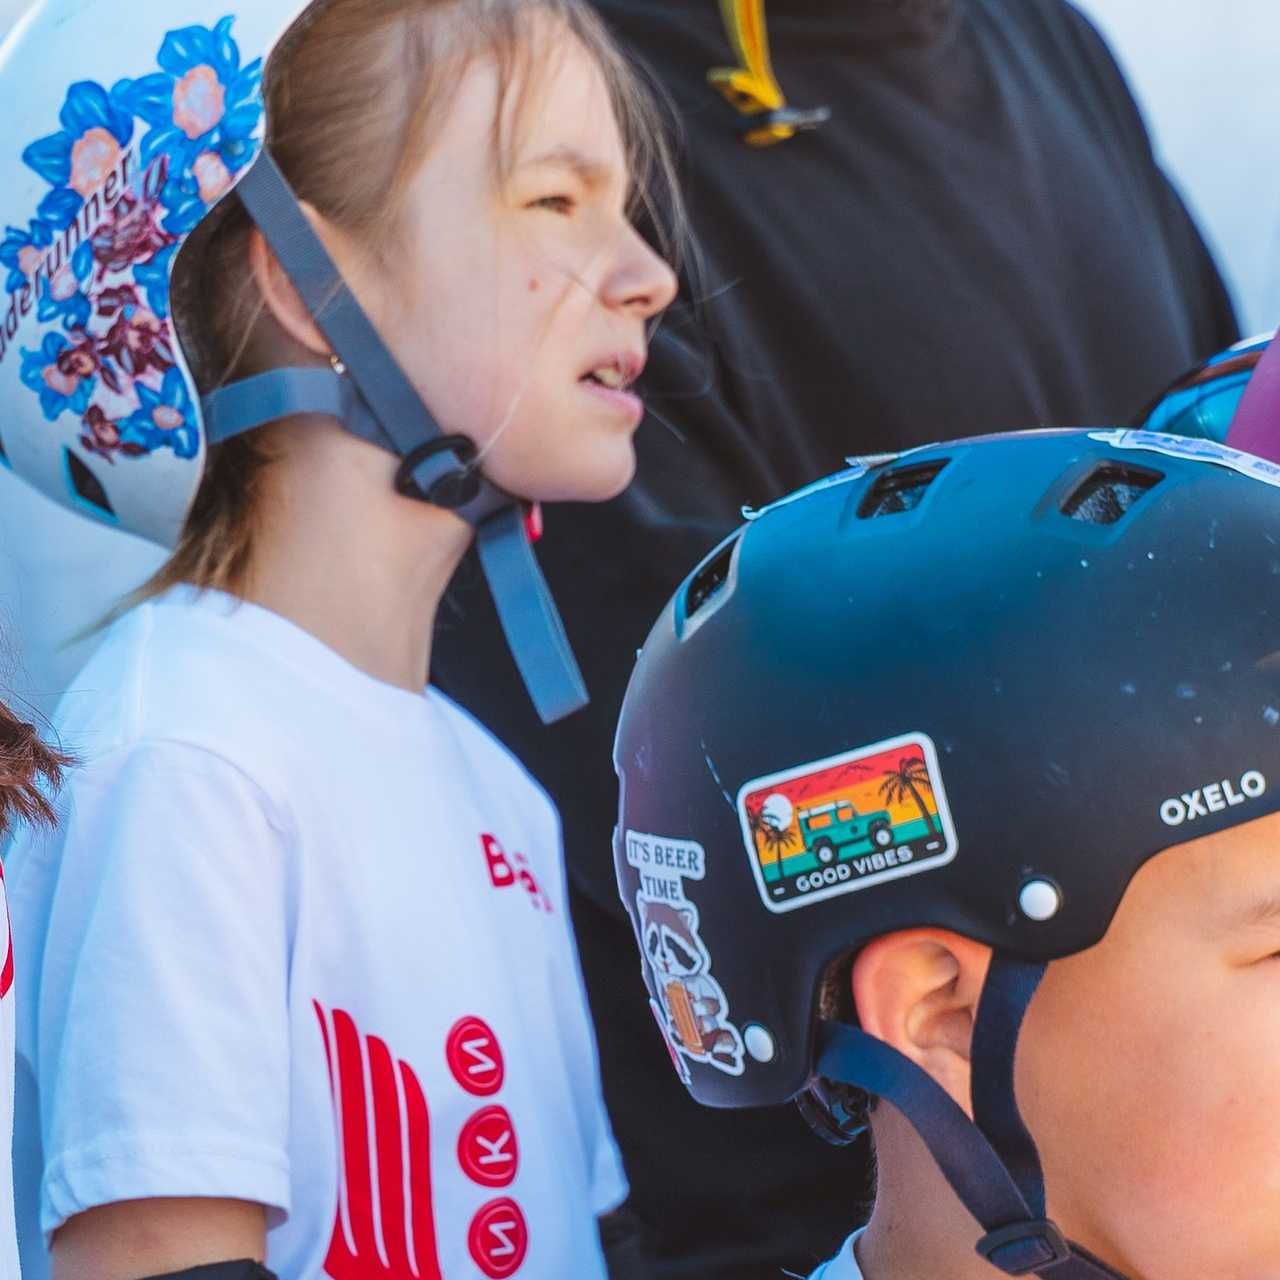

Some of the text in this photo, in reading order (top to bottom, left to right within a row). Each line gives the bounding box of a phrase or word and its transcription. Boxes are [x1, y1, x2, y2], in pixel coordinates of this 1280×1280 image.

[1160, 770, 1266, 826] OXELO
[628, 839, 700, 872] IT'S BEER
[795, 844, 914, 893] GOOD VIBES
[643, 874, 680, 901] TIME
